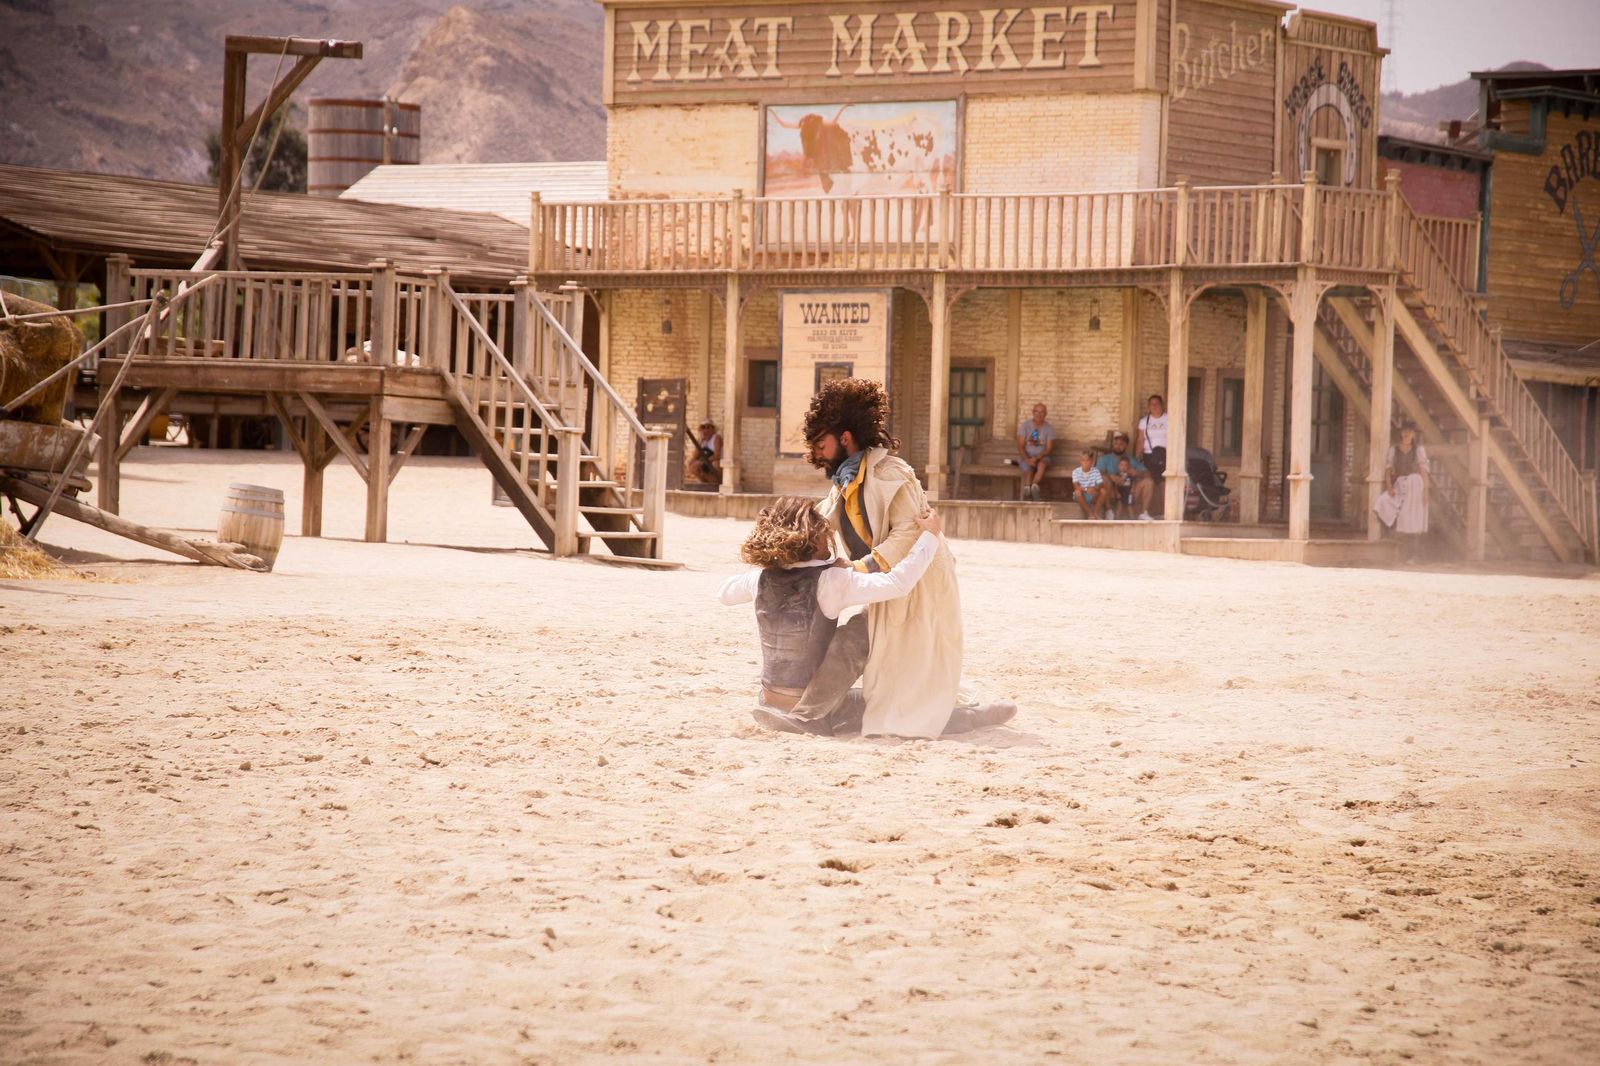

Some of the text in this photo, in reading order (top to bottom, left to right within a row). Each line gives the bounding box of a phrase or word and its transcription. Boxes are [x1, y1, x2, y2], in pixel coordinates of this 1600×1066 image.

[627, 5, 1116, 83] MEAT MARKET
[1171, 20, 1275, 102] Butcher
[1284, 56, 1326, 118] HORSE
[800, 303, 870, 324] WANTED
